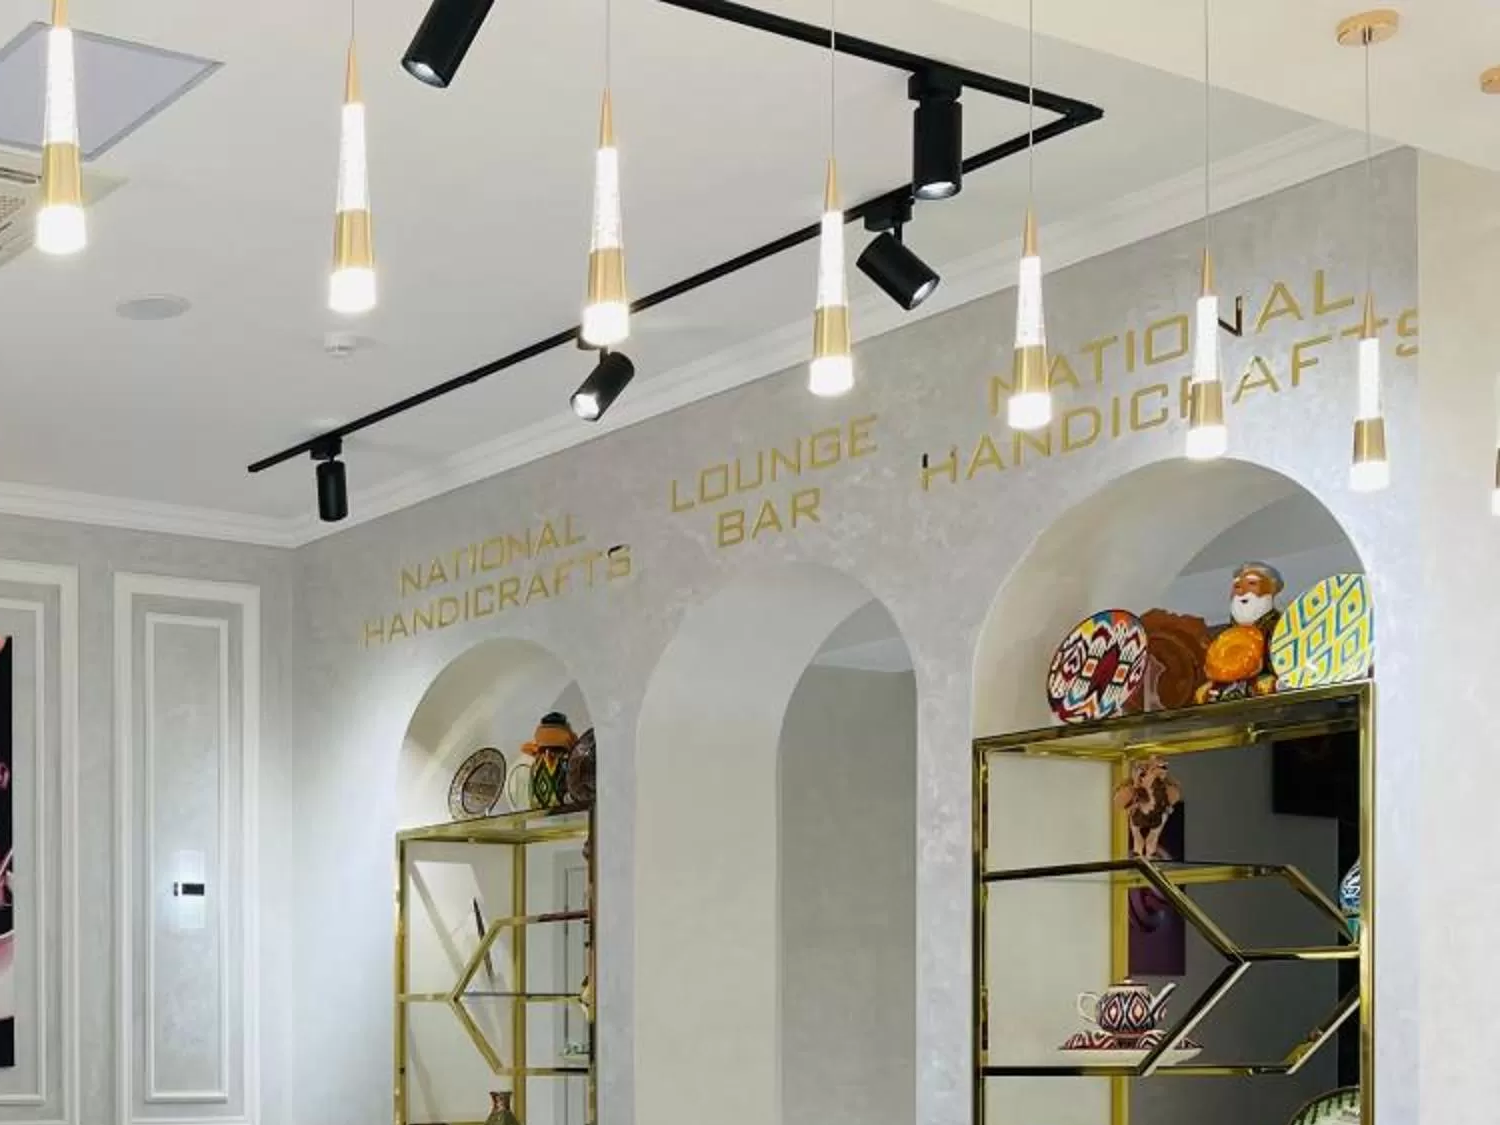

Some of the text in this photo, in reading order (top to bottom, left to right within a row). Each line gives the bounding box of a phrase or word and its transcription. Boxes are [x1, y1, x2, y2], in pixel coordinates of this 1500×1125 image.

[670, 413, 879, 514] LOUNGE
[399, 513, 587, 599] NATIONAL
[716, 487, 823, 549] BAR
[362, 545, 633, 649] HANDICRAFTS
